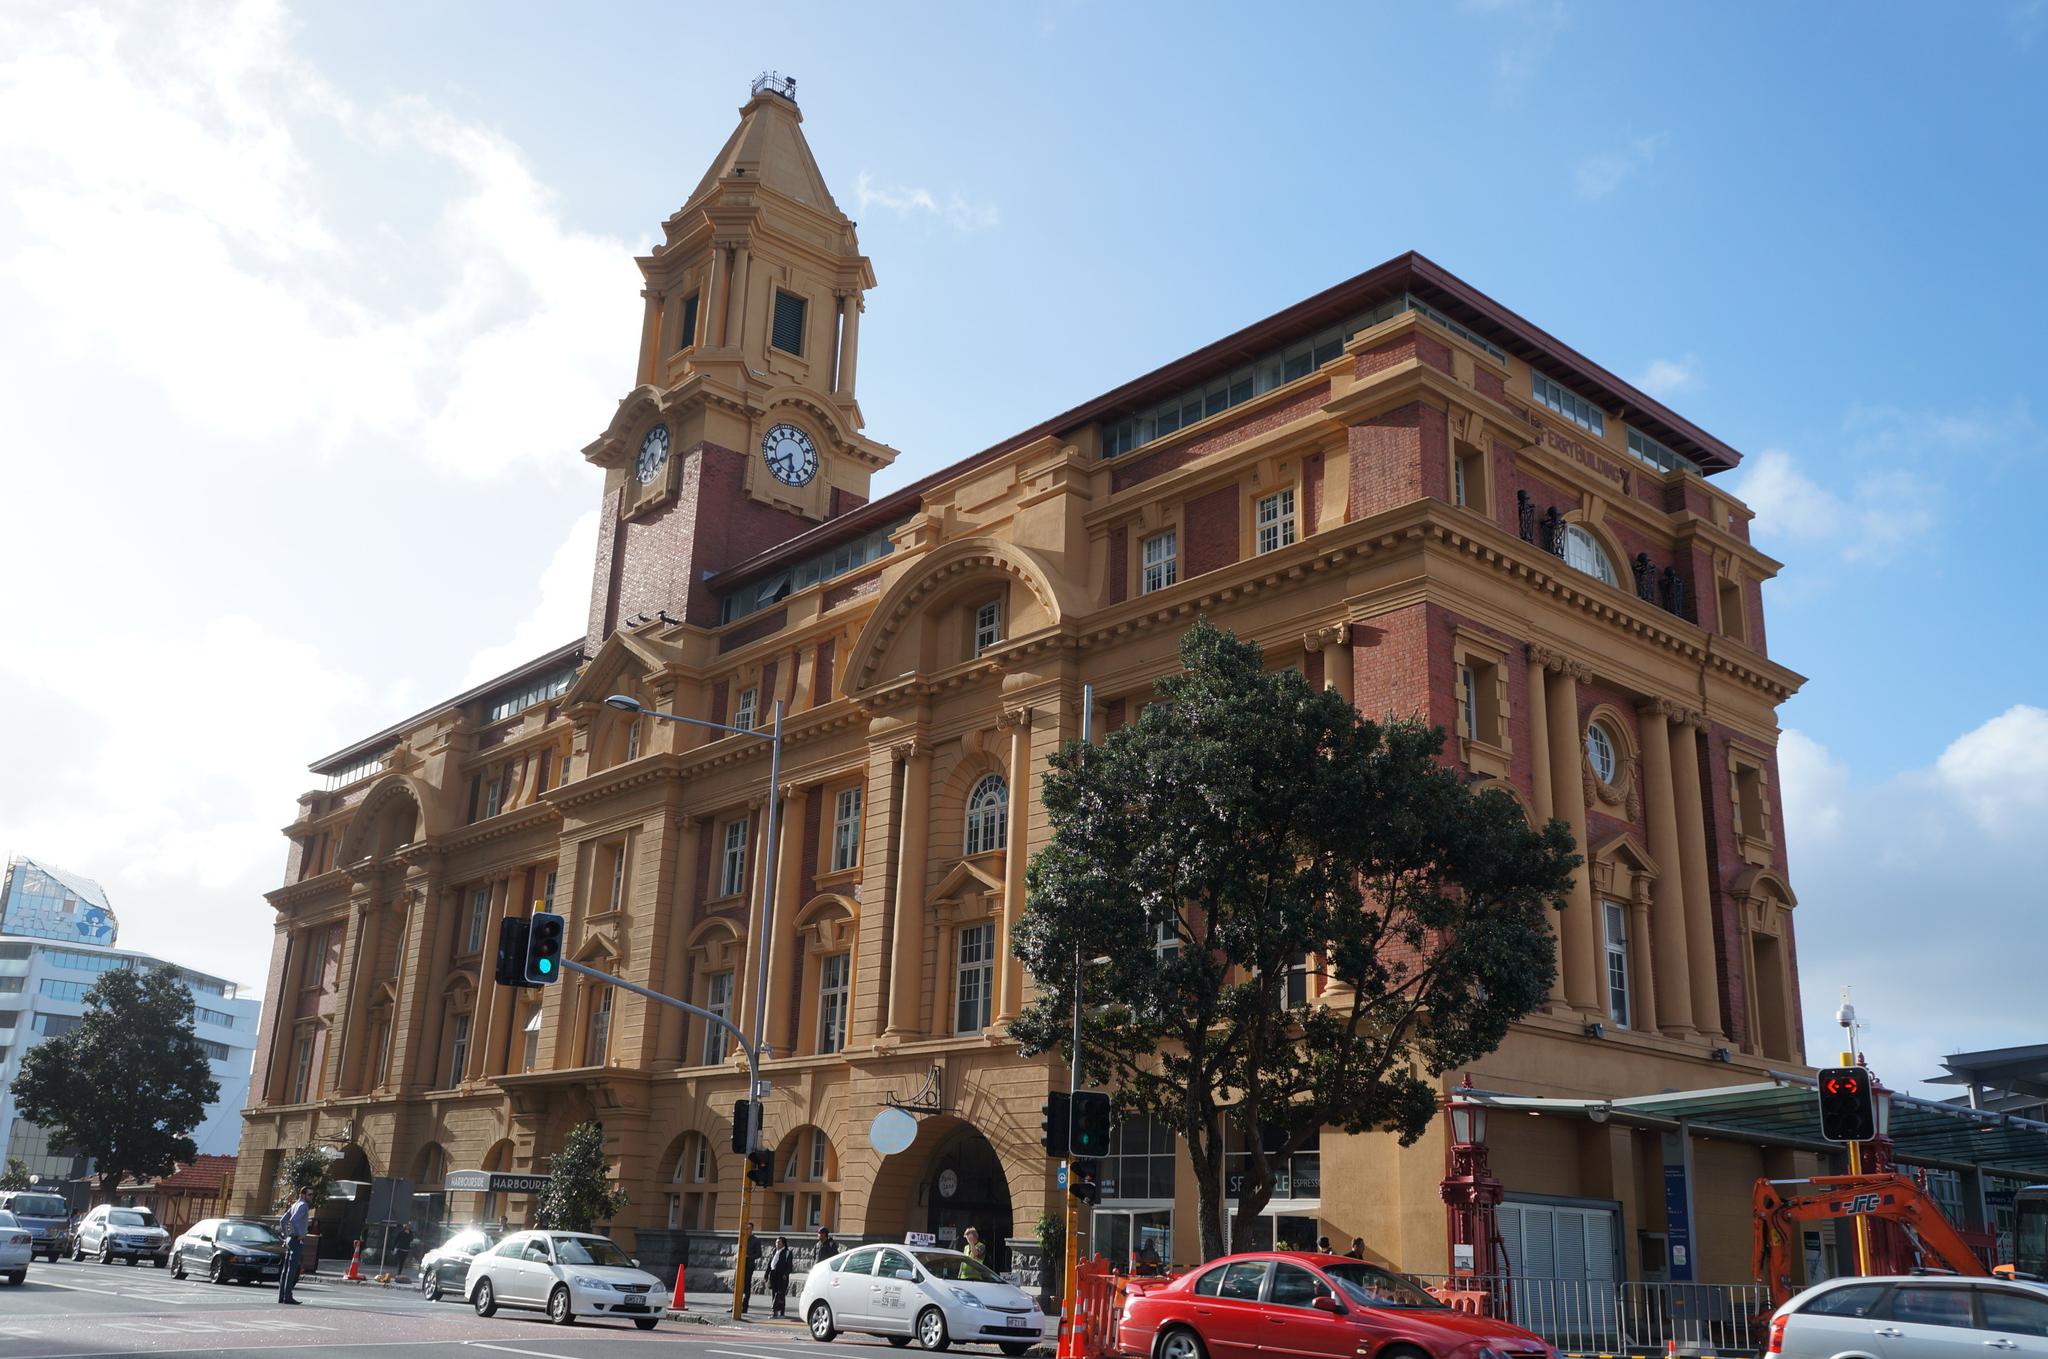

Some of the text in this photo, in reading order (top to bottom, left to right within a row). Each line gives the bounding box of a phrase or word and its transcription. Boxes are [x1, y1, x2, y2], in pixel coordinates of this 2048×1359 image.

[1541, 428, 1620, 483] FERRY BUILDING
[916, 1233, 930, 1241] TAXI
